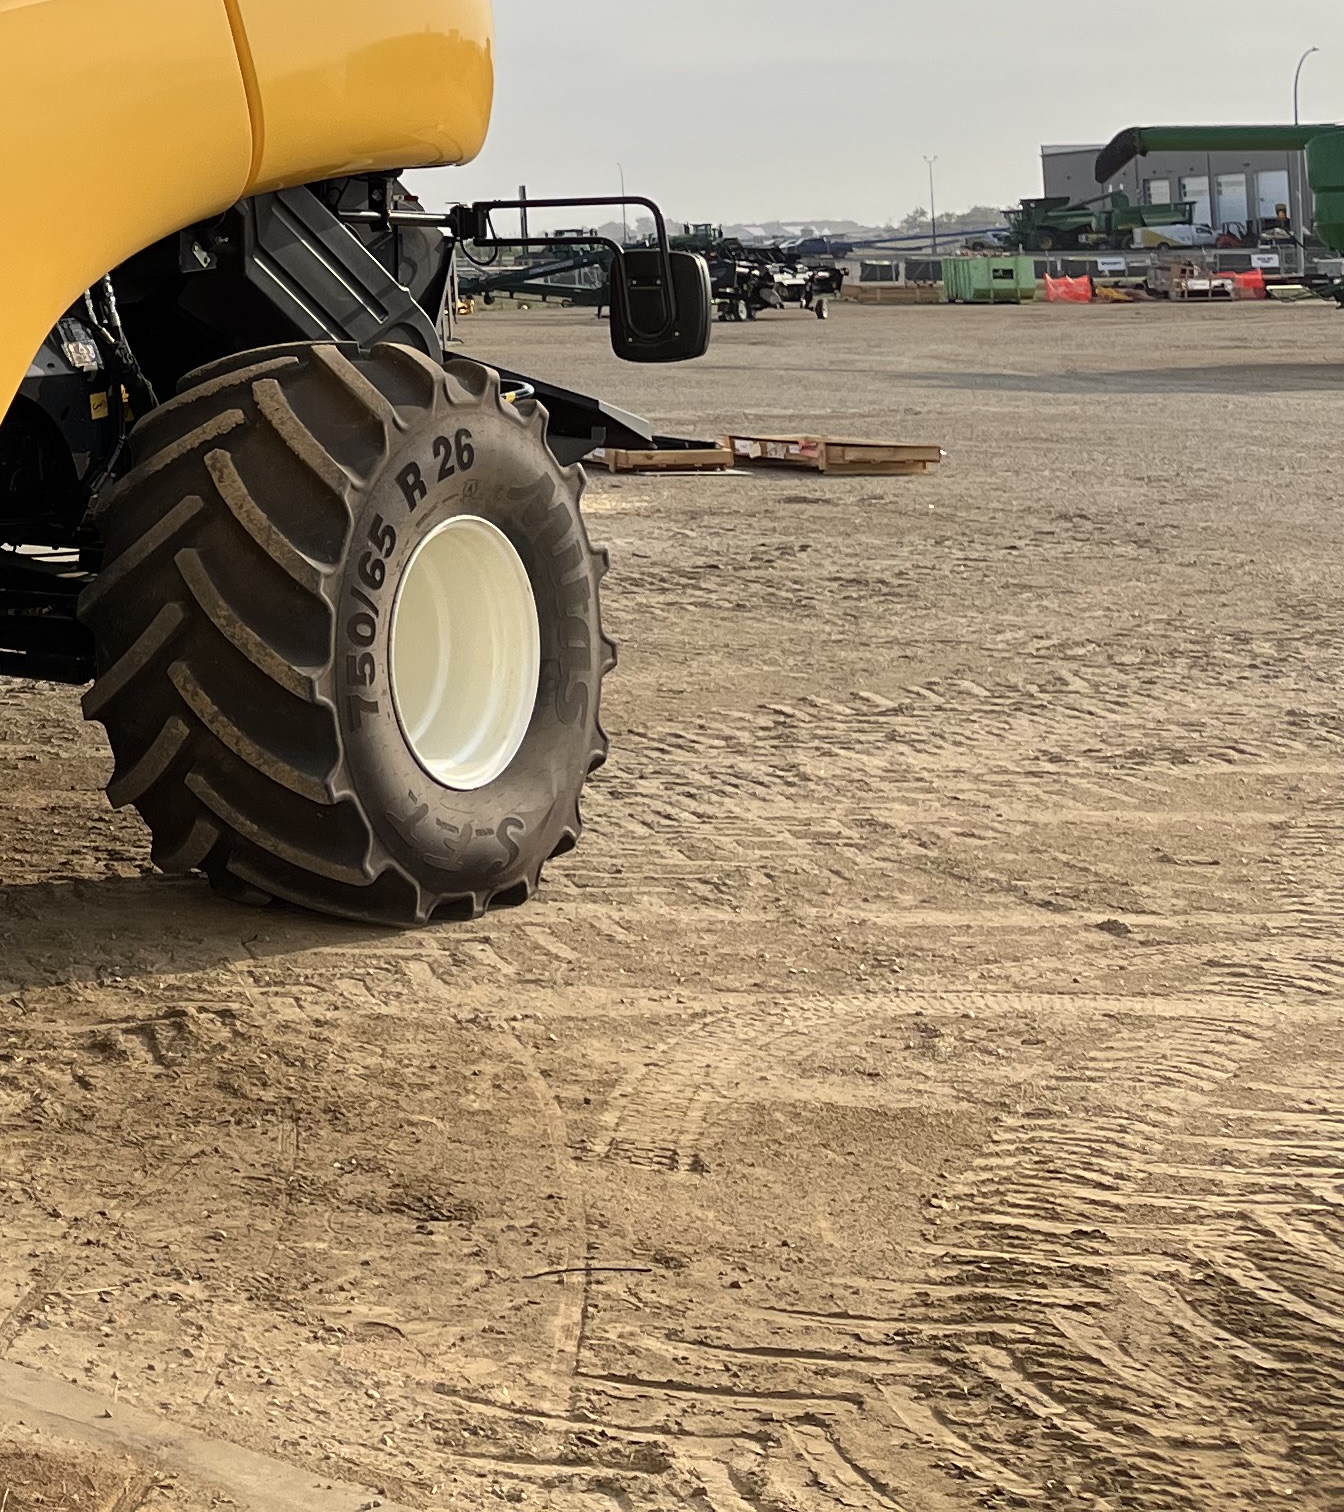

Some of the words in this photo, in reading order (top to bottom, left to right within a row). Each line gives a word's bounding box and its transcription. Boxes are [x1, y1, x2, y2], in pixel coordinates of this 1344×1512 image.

[346, 513, 397, 732] 750/65
[394, 461, 428, 513] R
[432, 428, 475, 483] 26
